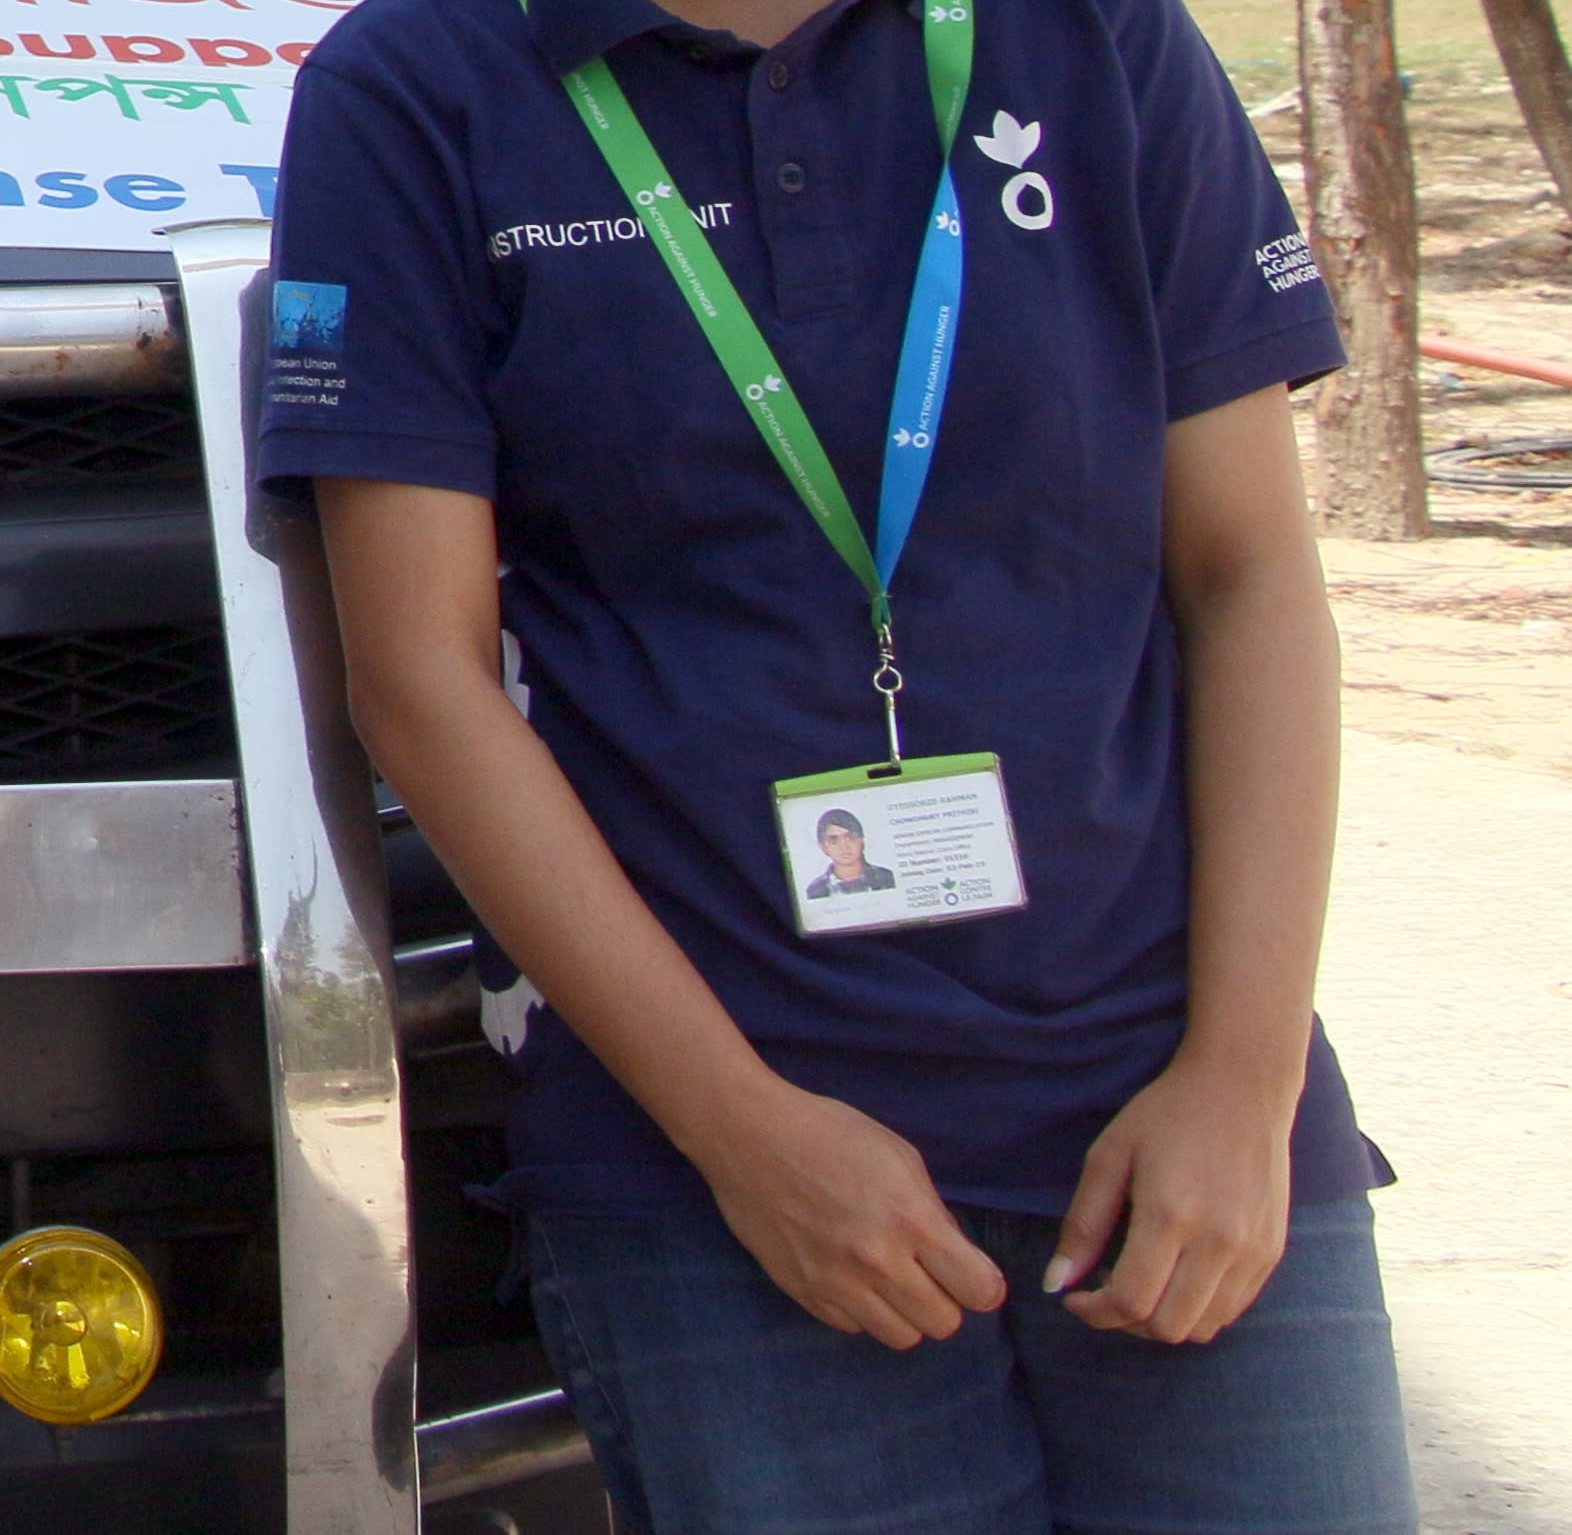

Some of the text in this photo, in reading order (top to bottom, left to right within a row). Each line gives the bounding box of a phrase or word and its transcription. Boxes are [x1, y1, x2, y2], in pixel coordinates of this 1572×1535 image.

[686, 201, 733, 230] NIT
[647, 204, 717, 319] ACTION AGAINST HUNGER
[1255, 232, 1307, 266] ACTION
[1262, 248, 1312, 279] AGAINST
[1268, 264, 1321, 293] HUNGER
[303, 358, 337, 371] Union
[917, 304, 951, 430] ACTION AGAINST HUNGER
[318, 393, 339, 406] Aid
[756, 399, 784, 437] ACTION
